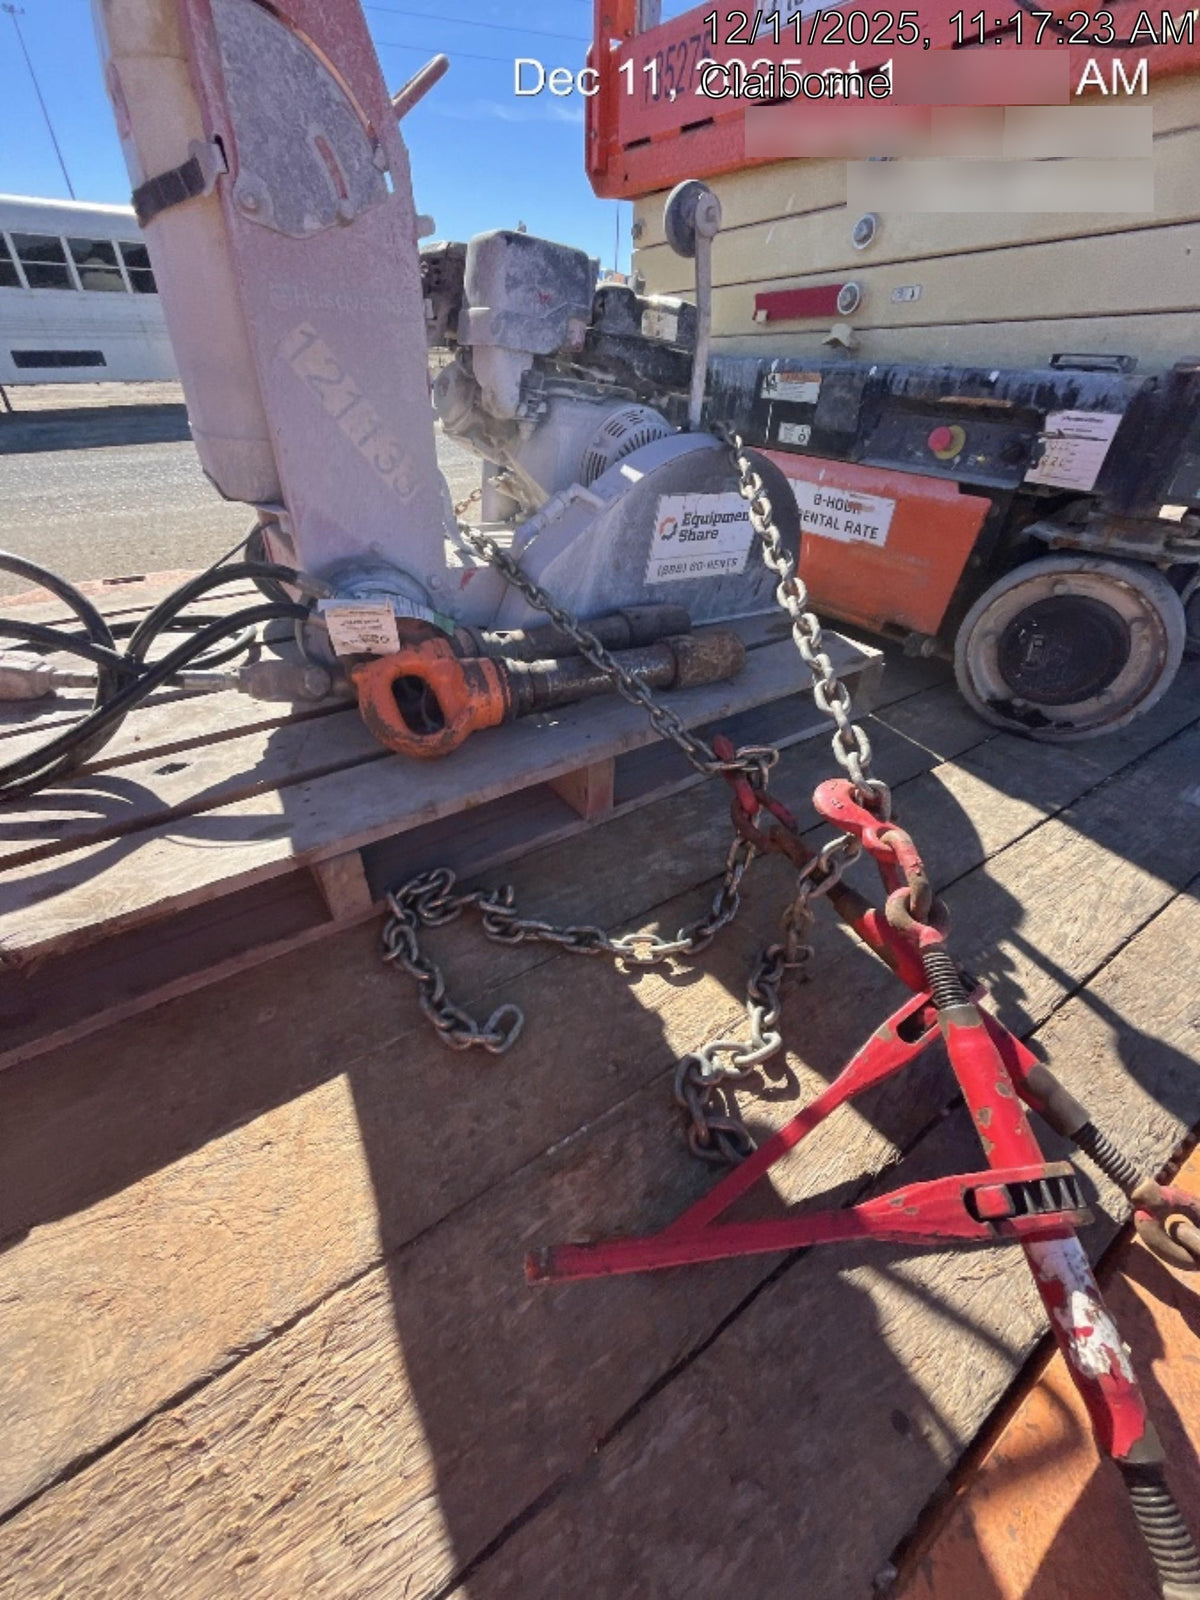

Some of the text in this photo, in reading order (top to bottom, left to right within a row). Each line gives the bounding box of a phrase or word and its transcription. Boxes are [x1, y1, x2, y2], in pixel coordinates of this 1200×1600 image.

[813, 493, 860, 515] 8-HOUR
[681, 509, 750, 528] Equipmen
[678, 528, 719, 543] Share
[844, 520, 879, 539] RATE
